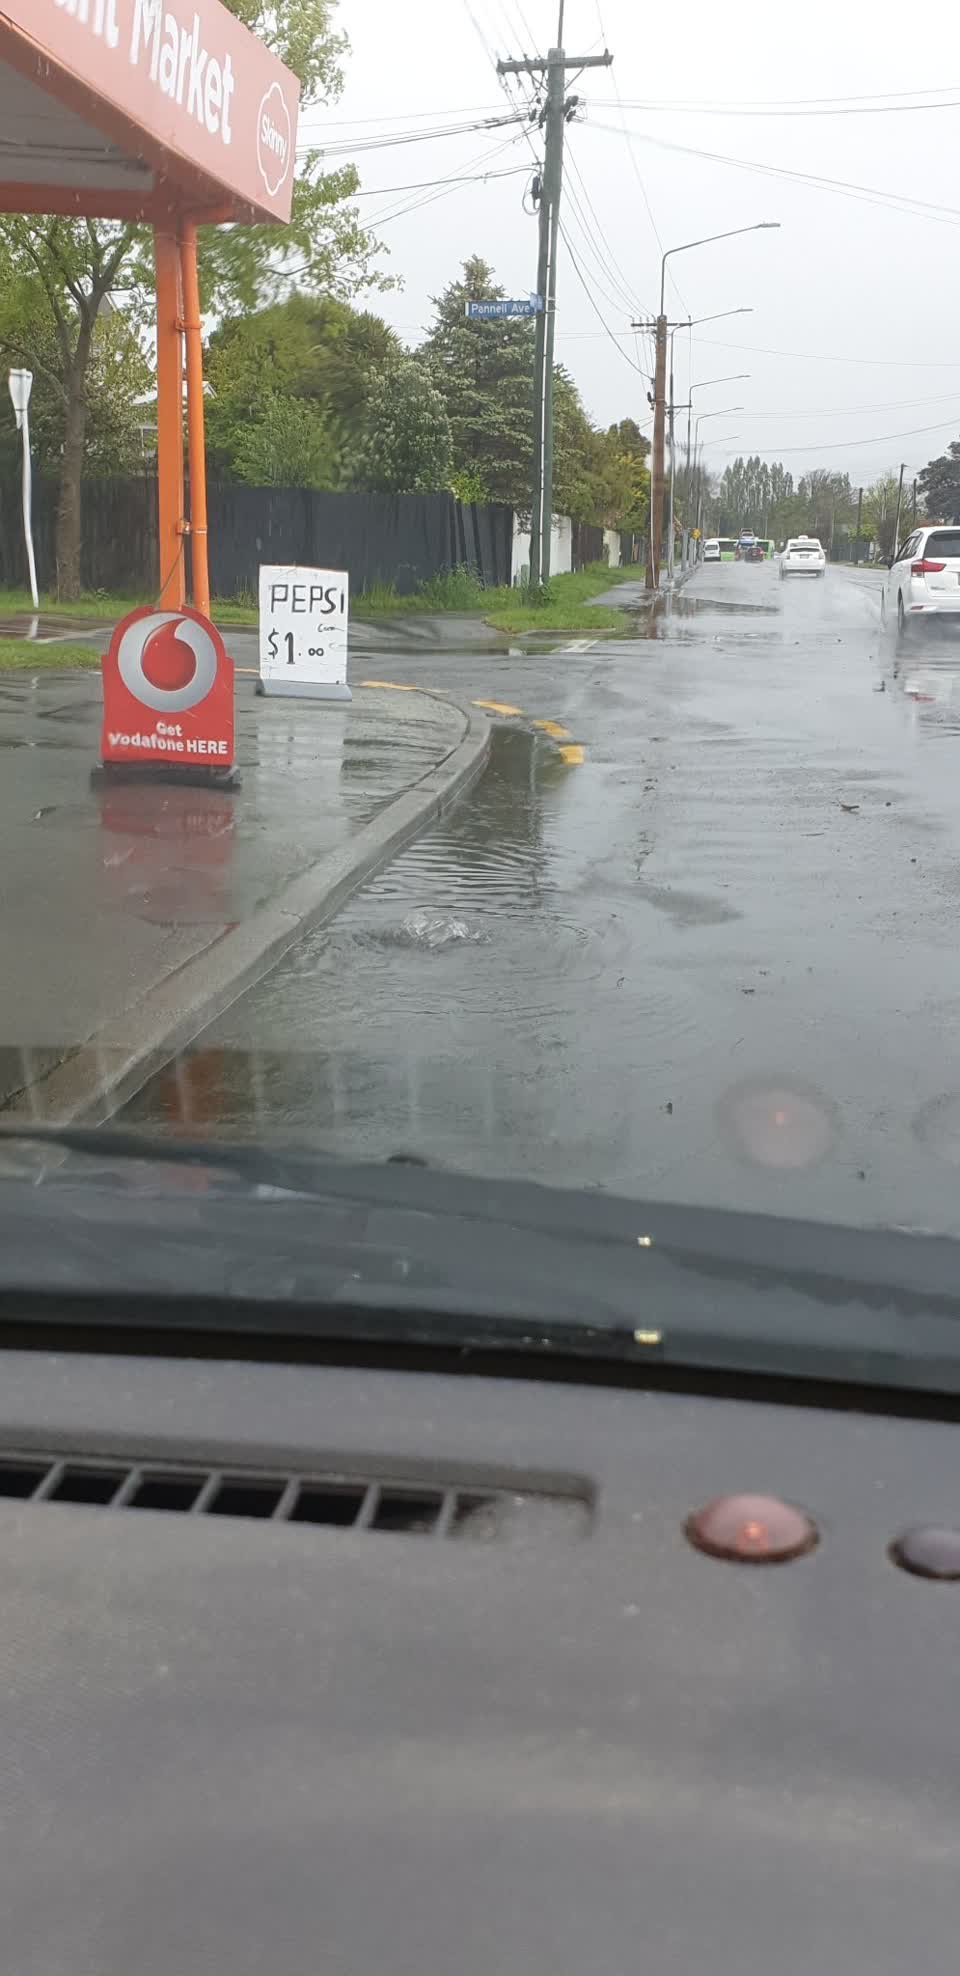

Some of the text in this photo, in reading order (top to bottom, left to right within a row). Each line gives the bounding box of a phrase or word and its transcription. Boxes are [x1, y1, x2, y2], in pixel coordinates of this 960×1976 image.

[129, 0, 234, 145] Market
[261, 114, 288, 164] Skinny
[471, 303, 530, 313] Pannell Ave
[270, 584, 345, 615] PEPSI
[156, 721, 183, 736] Get
[108, 731, 228, 755] Vodafone HERE
